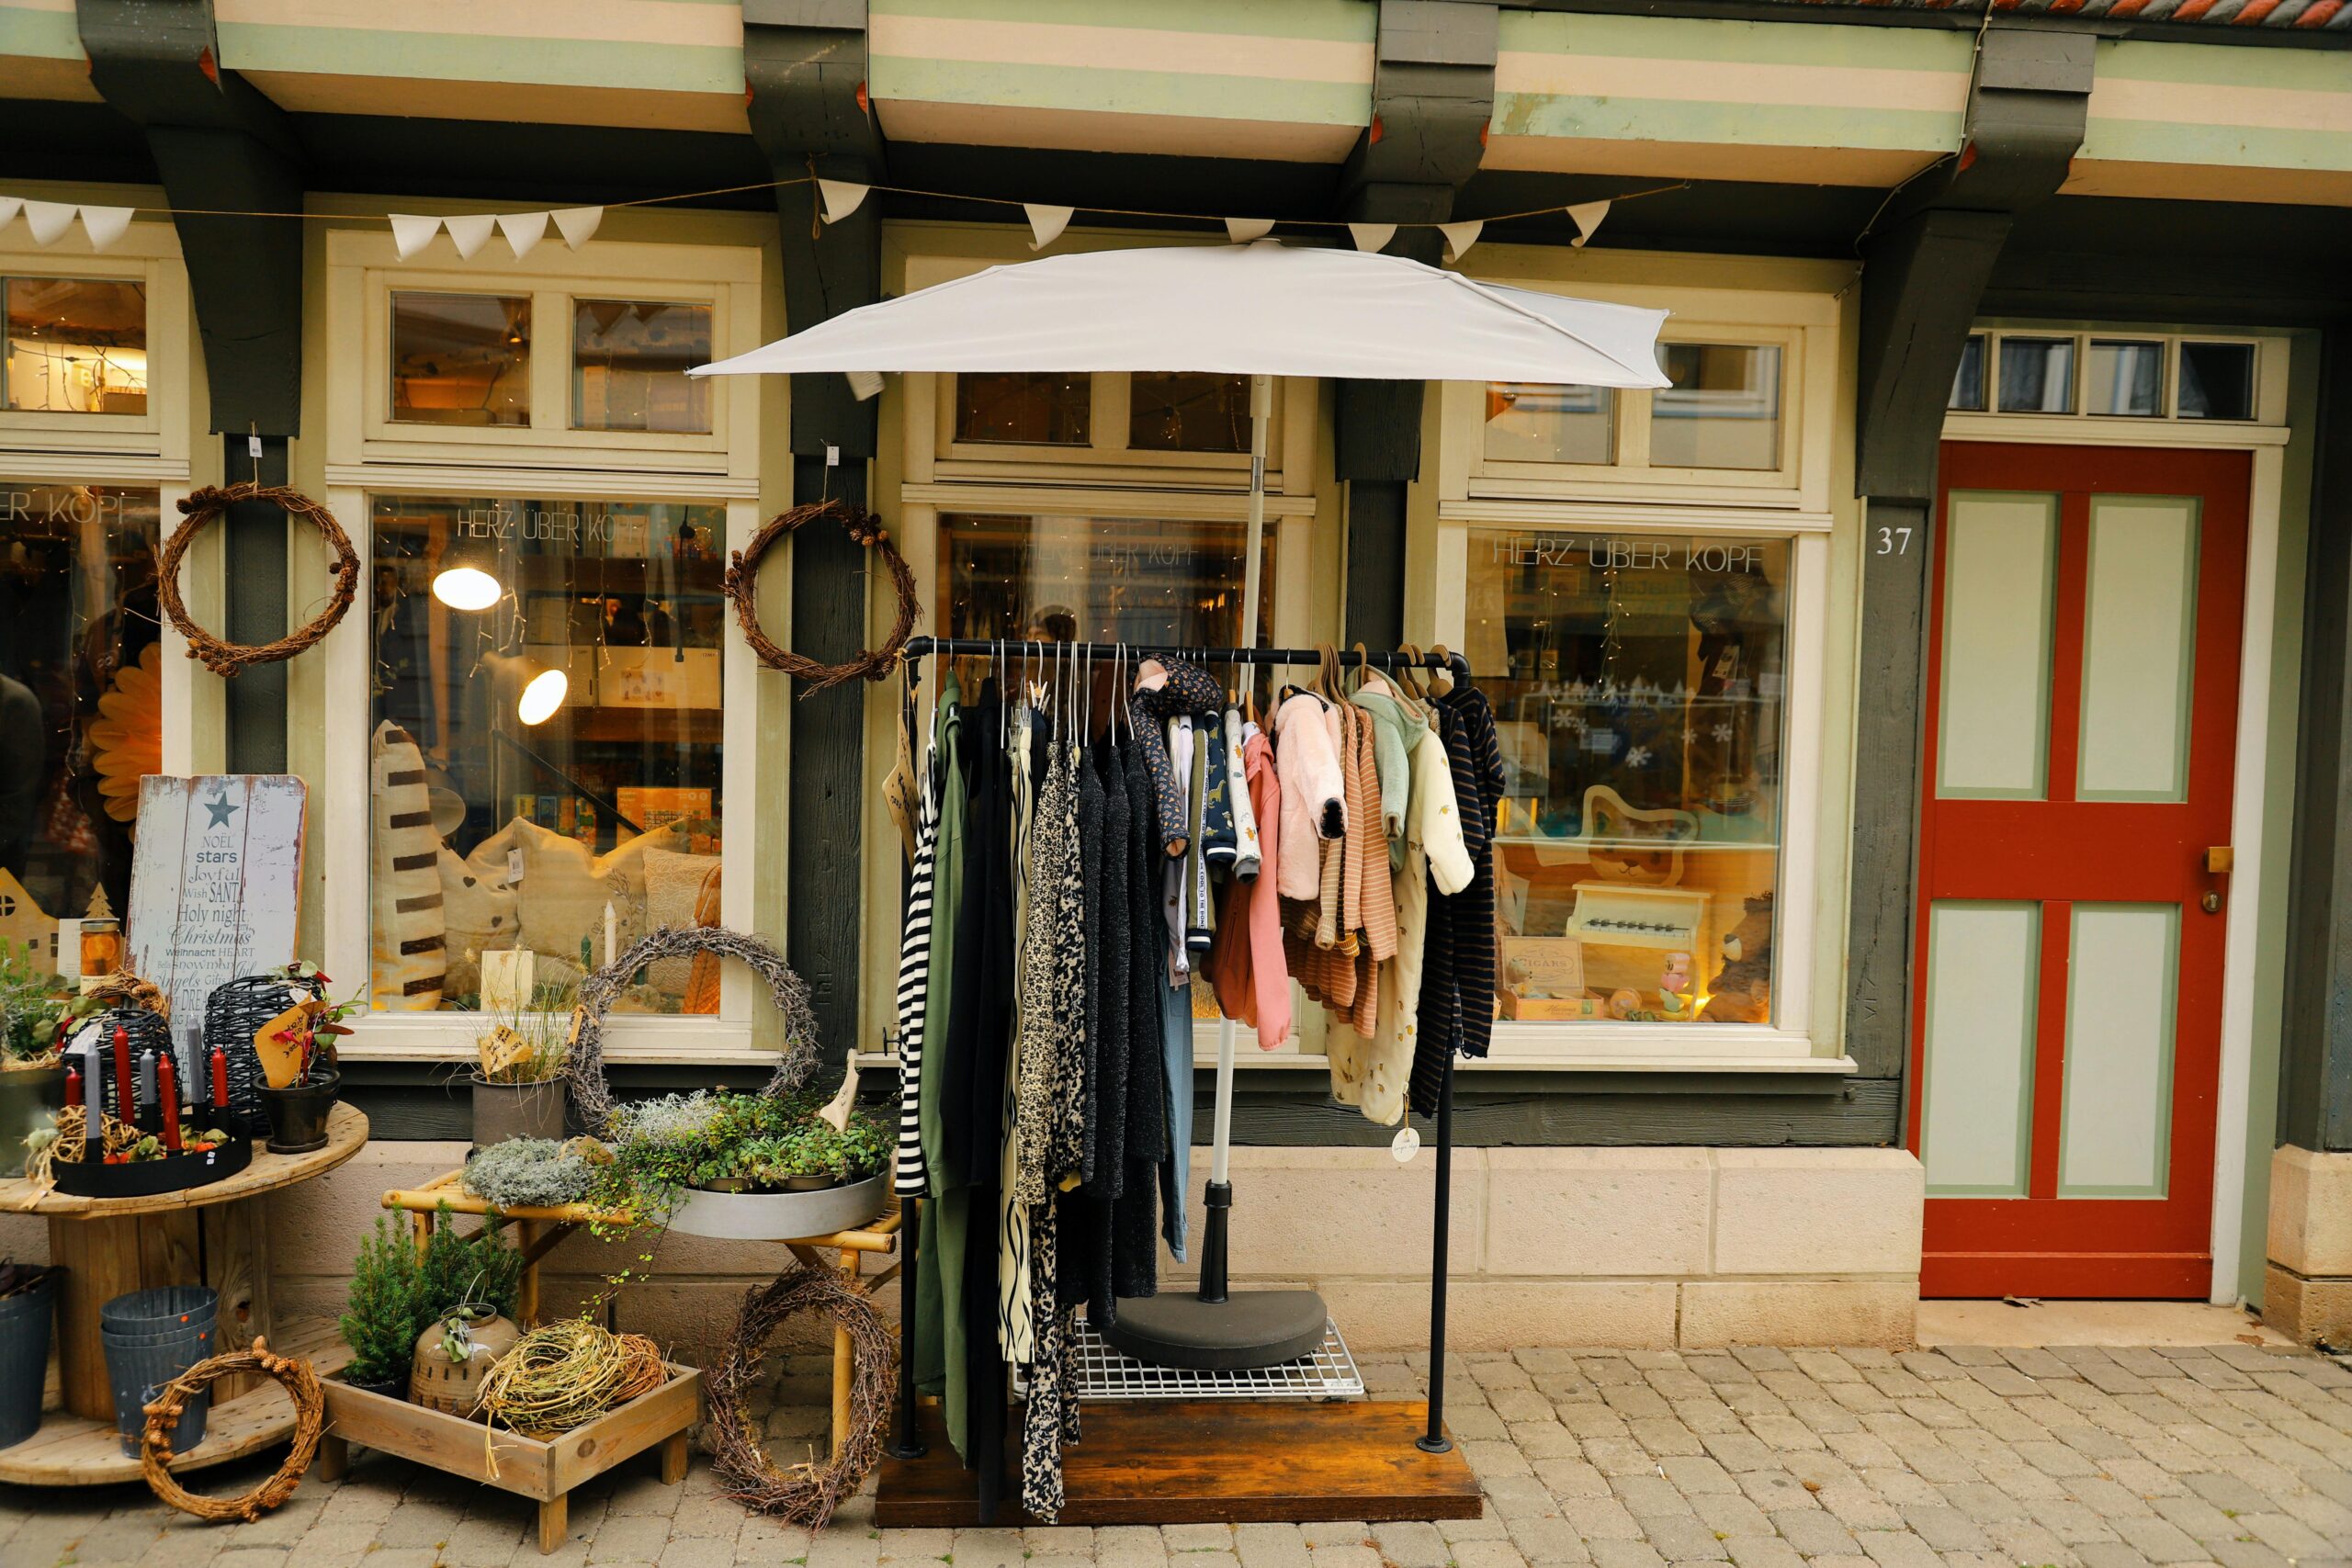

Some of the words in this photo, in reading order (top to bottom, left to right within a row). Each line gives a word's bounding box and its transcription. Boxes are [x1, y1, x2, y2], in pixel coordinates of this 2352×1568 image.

[49, 493, 141, 524] KOPF
[458, 509, 513, 538] HERZ
[522, 508, 579, 542] ÜBER
[1876, 526, 1912, 555] 37
[1493, 536, 1575, 566] HERZ
[1589, 537, 1670, 570] ÜBER
[1685, 544, 1766, 573] KOPF
[200, 832, 233, 849] NOËL
[196, 851, 237, 863] stars
[188, 864, 240, 886] Joyful
[183, 887, 208, 898] Wish
[209, 881, 244, 903] SANTA
[178, 903, 209, 928] Holy
[211, 904, 246, 928] night
[167, 923, 252, 946] Christmas
[218, 947, 255, 957] HEART
[1520, 958, 1566, 967] IGARS
[153, 970, 200, 995] Angels
[181, 989, 208, 1010] DREA
